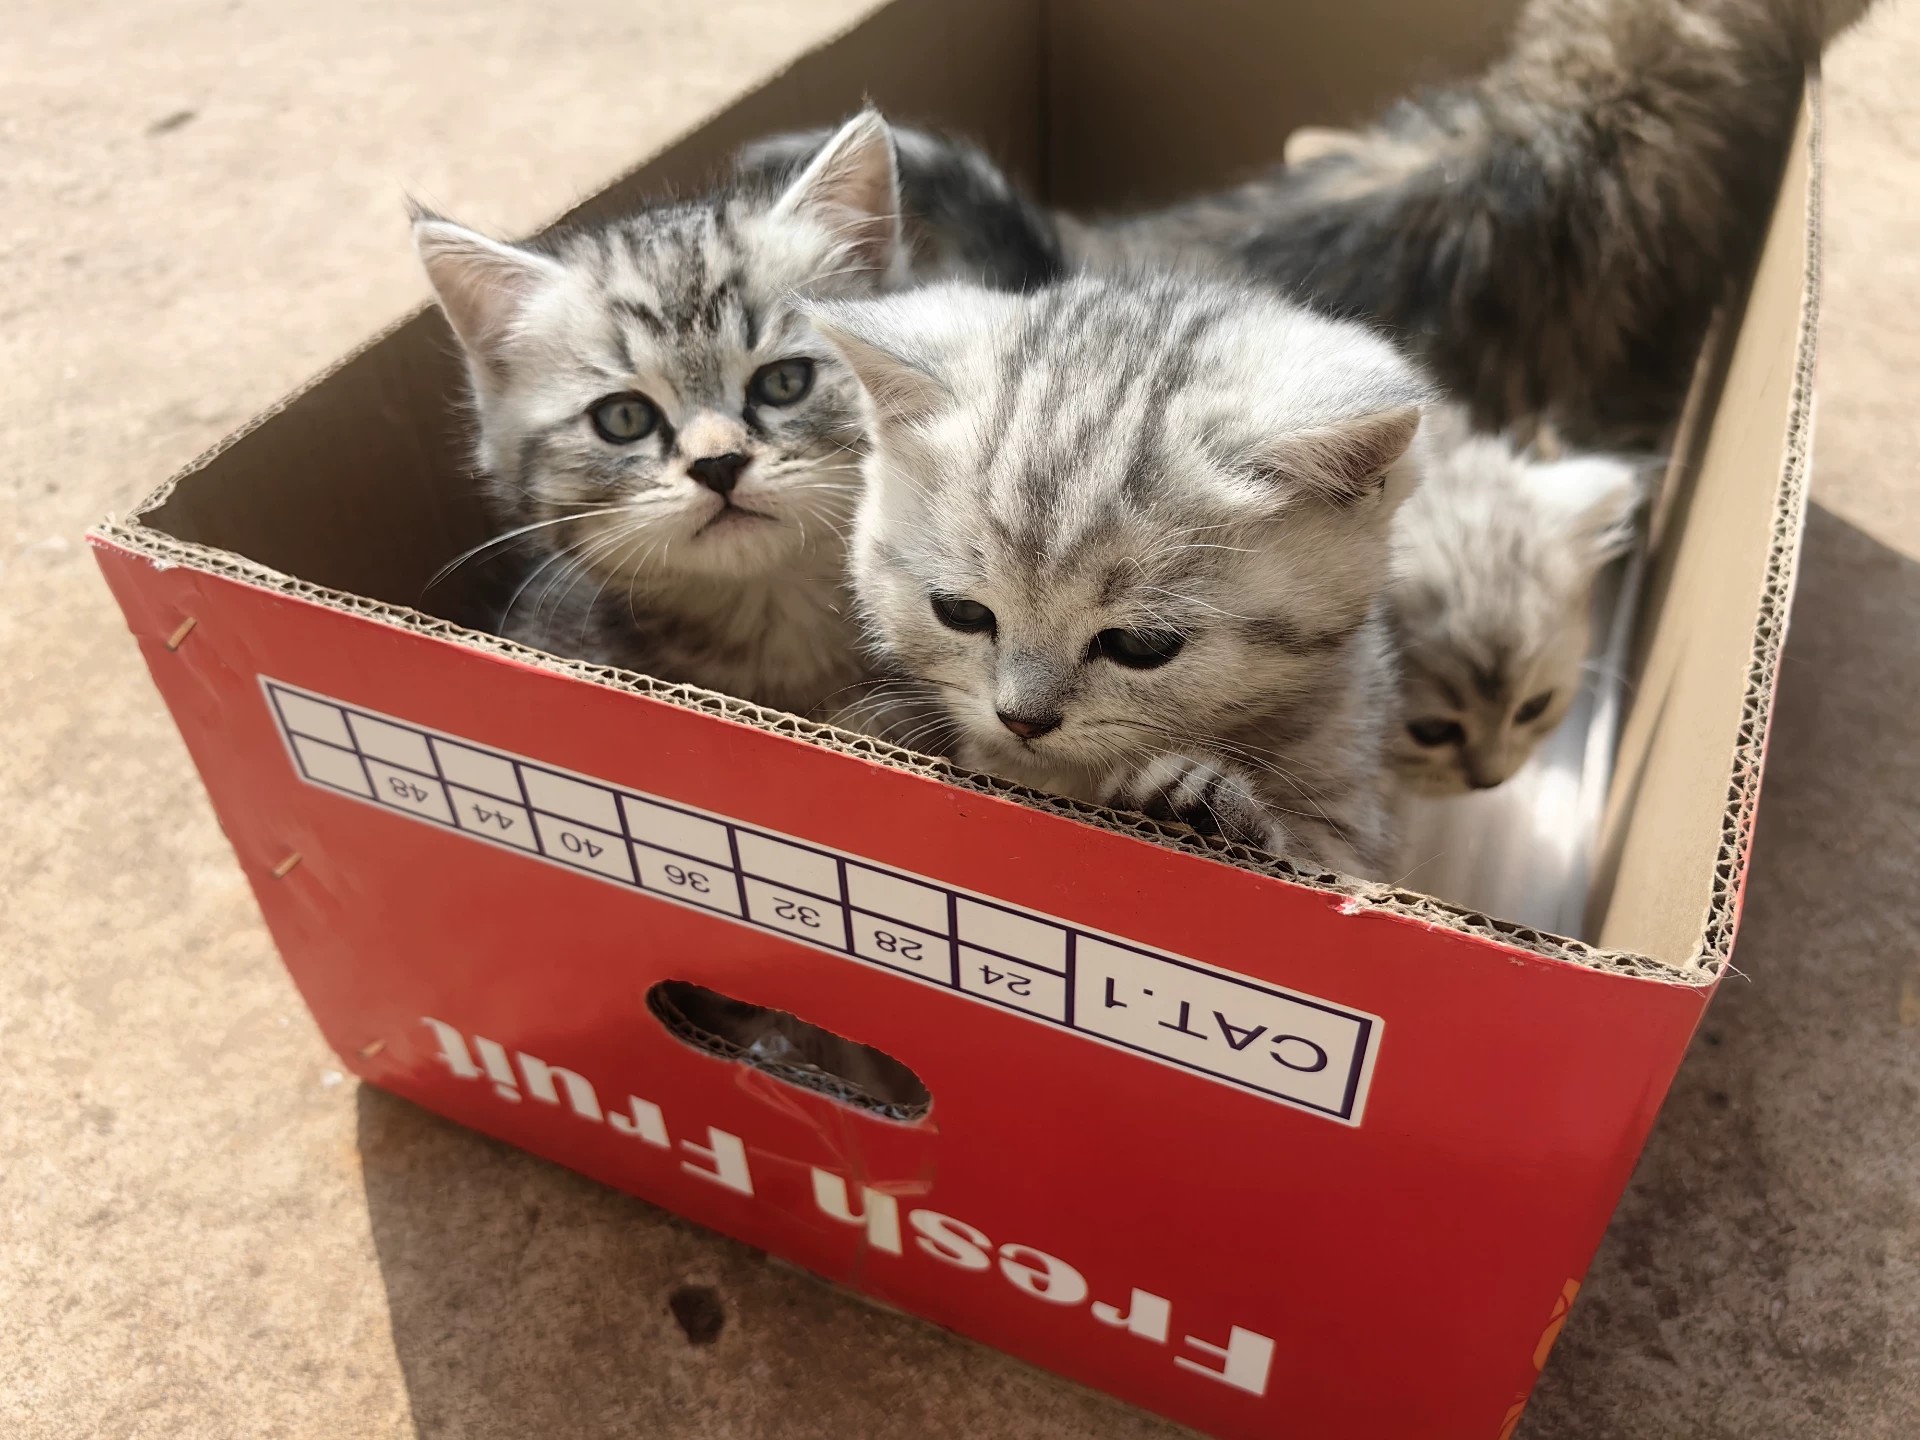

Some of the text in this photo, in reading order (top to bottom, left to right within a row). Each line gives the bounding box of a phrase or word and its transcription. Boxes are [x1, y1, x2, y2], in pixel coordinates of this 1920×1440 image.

[388, 776, 1328, 1073] CAT.1 24 28 32 36 40 44 48
[420, 1016, 1274, 1395] Fresh Fruit
